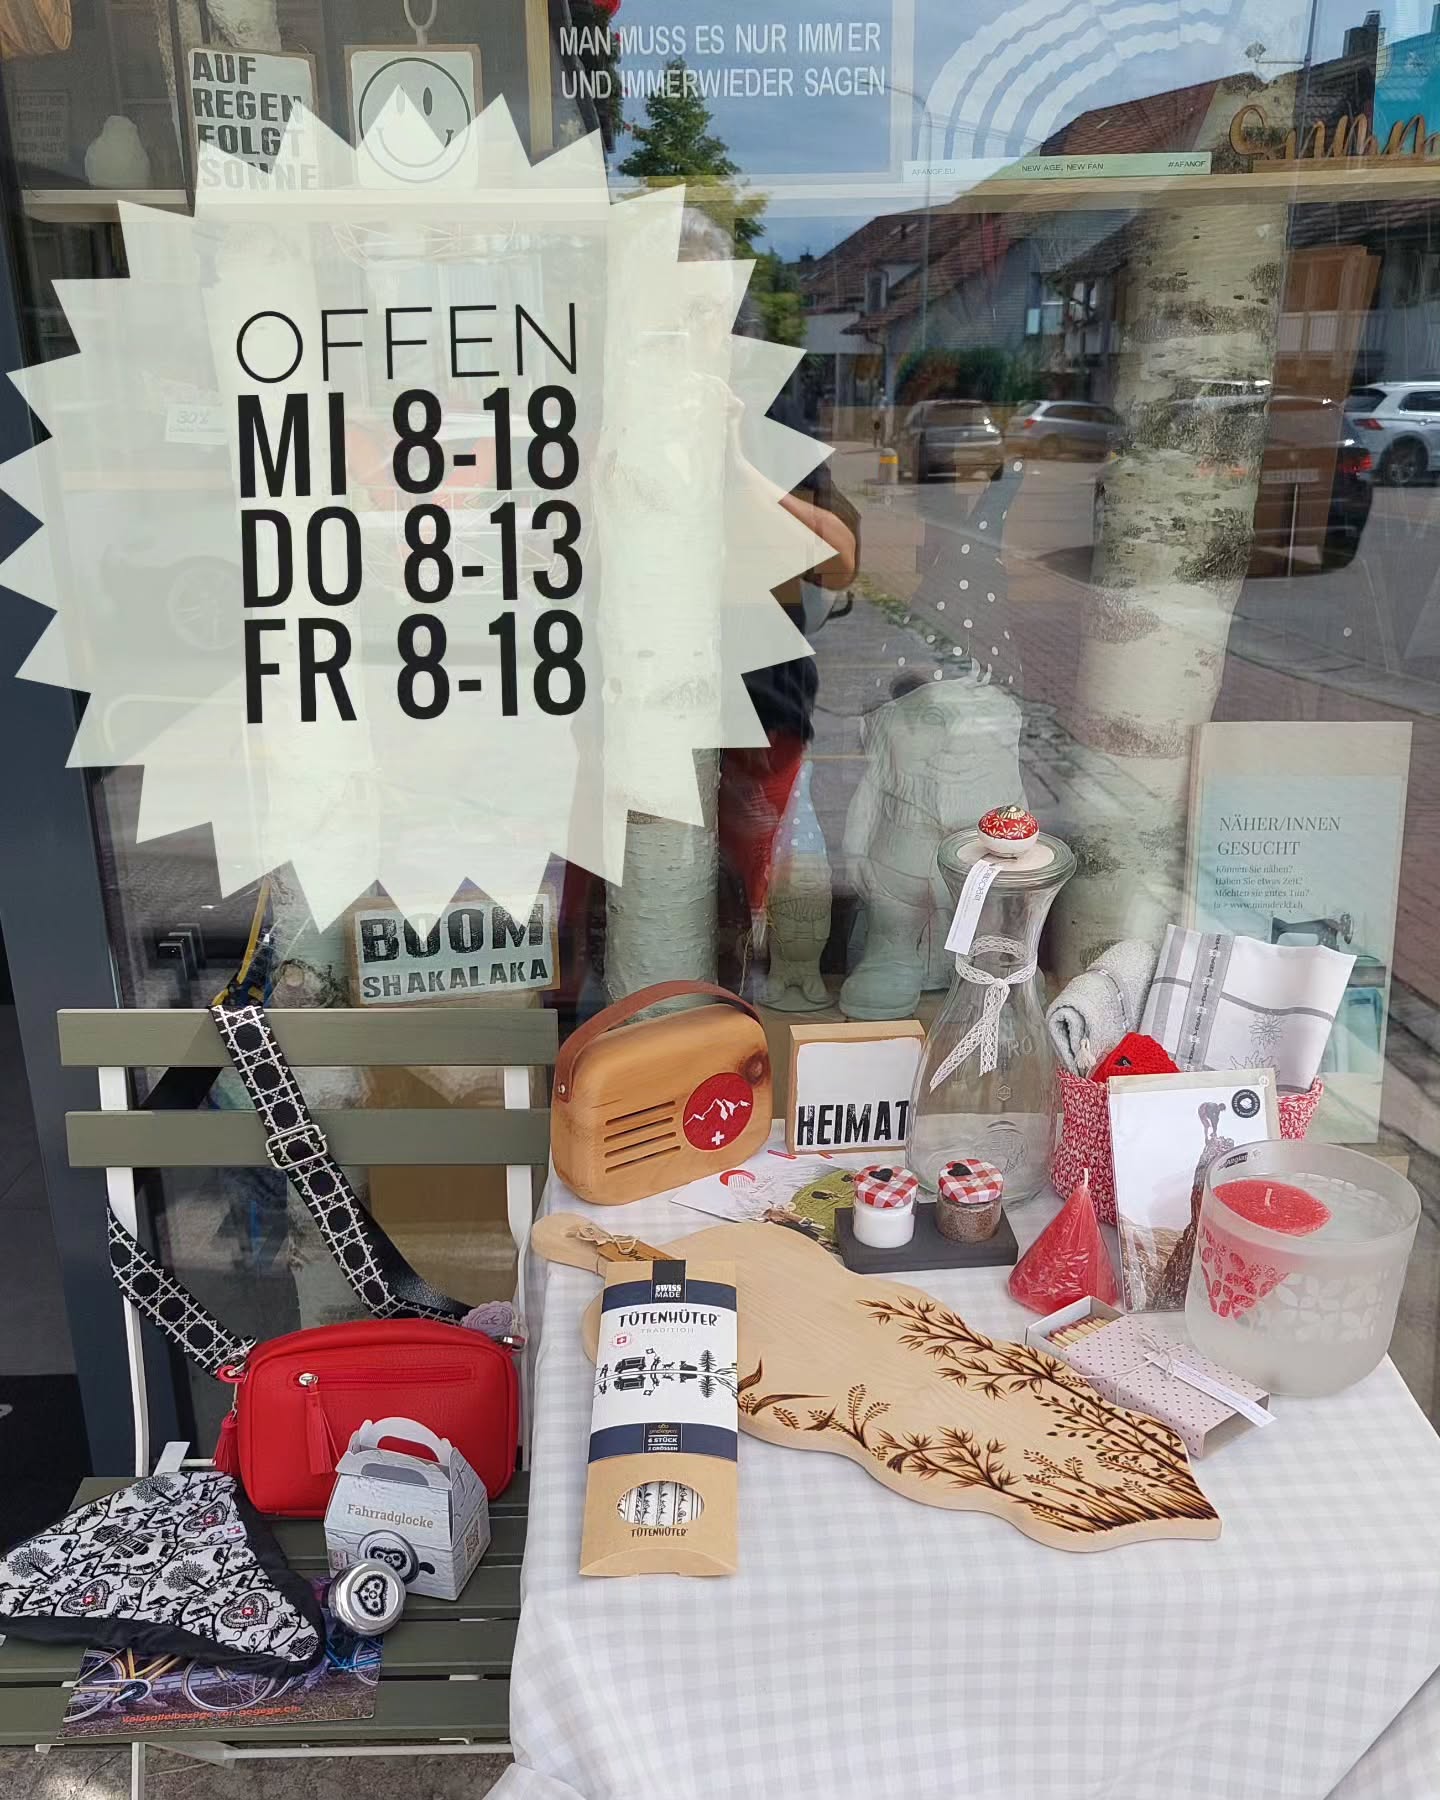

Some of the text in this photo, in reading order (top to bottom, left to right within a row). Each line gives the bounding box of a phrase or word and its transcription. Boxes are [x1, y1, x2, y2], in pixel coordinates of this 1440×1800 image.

[560, 22, 881, 57] MAN MUSS ES NUR IMMER
[193, 52, 257, 85] AUF
[561, 70, 612, 99] UND
[804, 66, 885, 97] SAGEN
[193, 88, 303, 123] REGEN
[198, 124, 305, 157] FOLGT
[1066, 163, 1087, 171] NEW
[1219, 814, 1342, 831] NÄHER/INNEN
[1217, 841, 1301, 855] GESUCHT
[1215, 877, 1241, 885] Haben
[1243, 877, 1255, 885] Sie
[1249, 864, 1261, 873] Sie
[360, 904, 544, 963] BOOM
[362, 958, 549, 998] SHAKALAKA
[796, 1100, 910, 1146] HEIMAT
[655, 1284, 682, 1292] SWISS
[347, 1503, 434, 1529] Fahrradglocke
